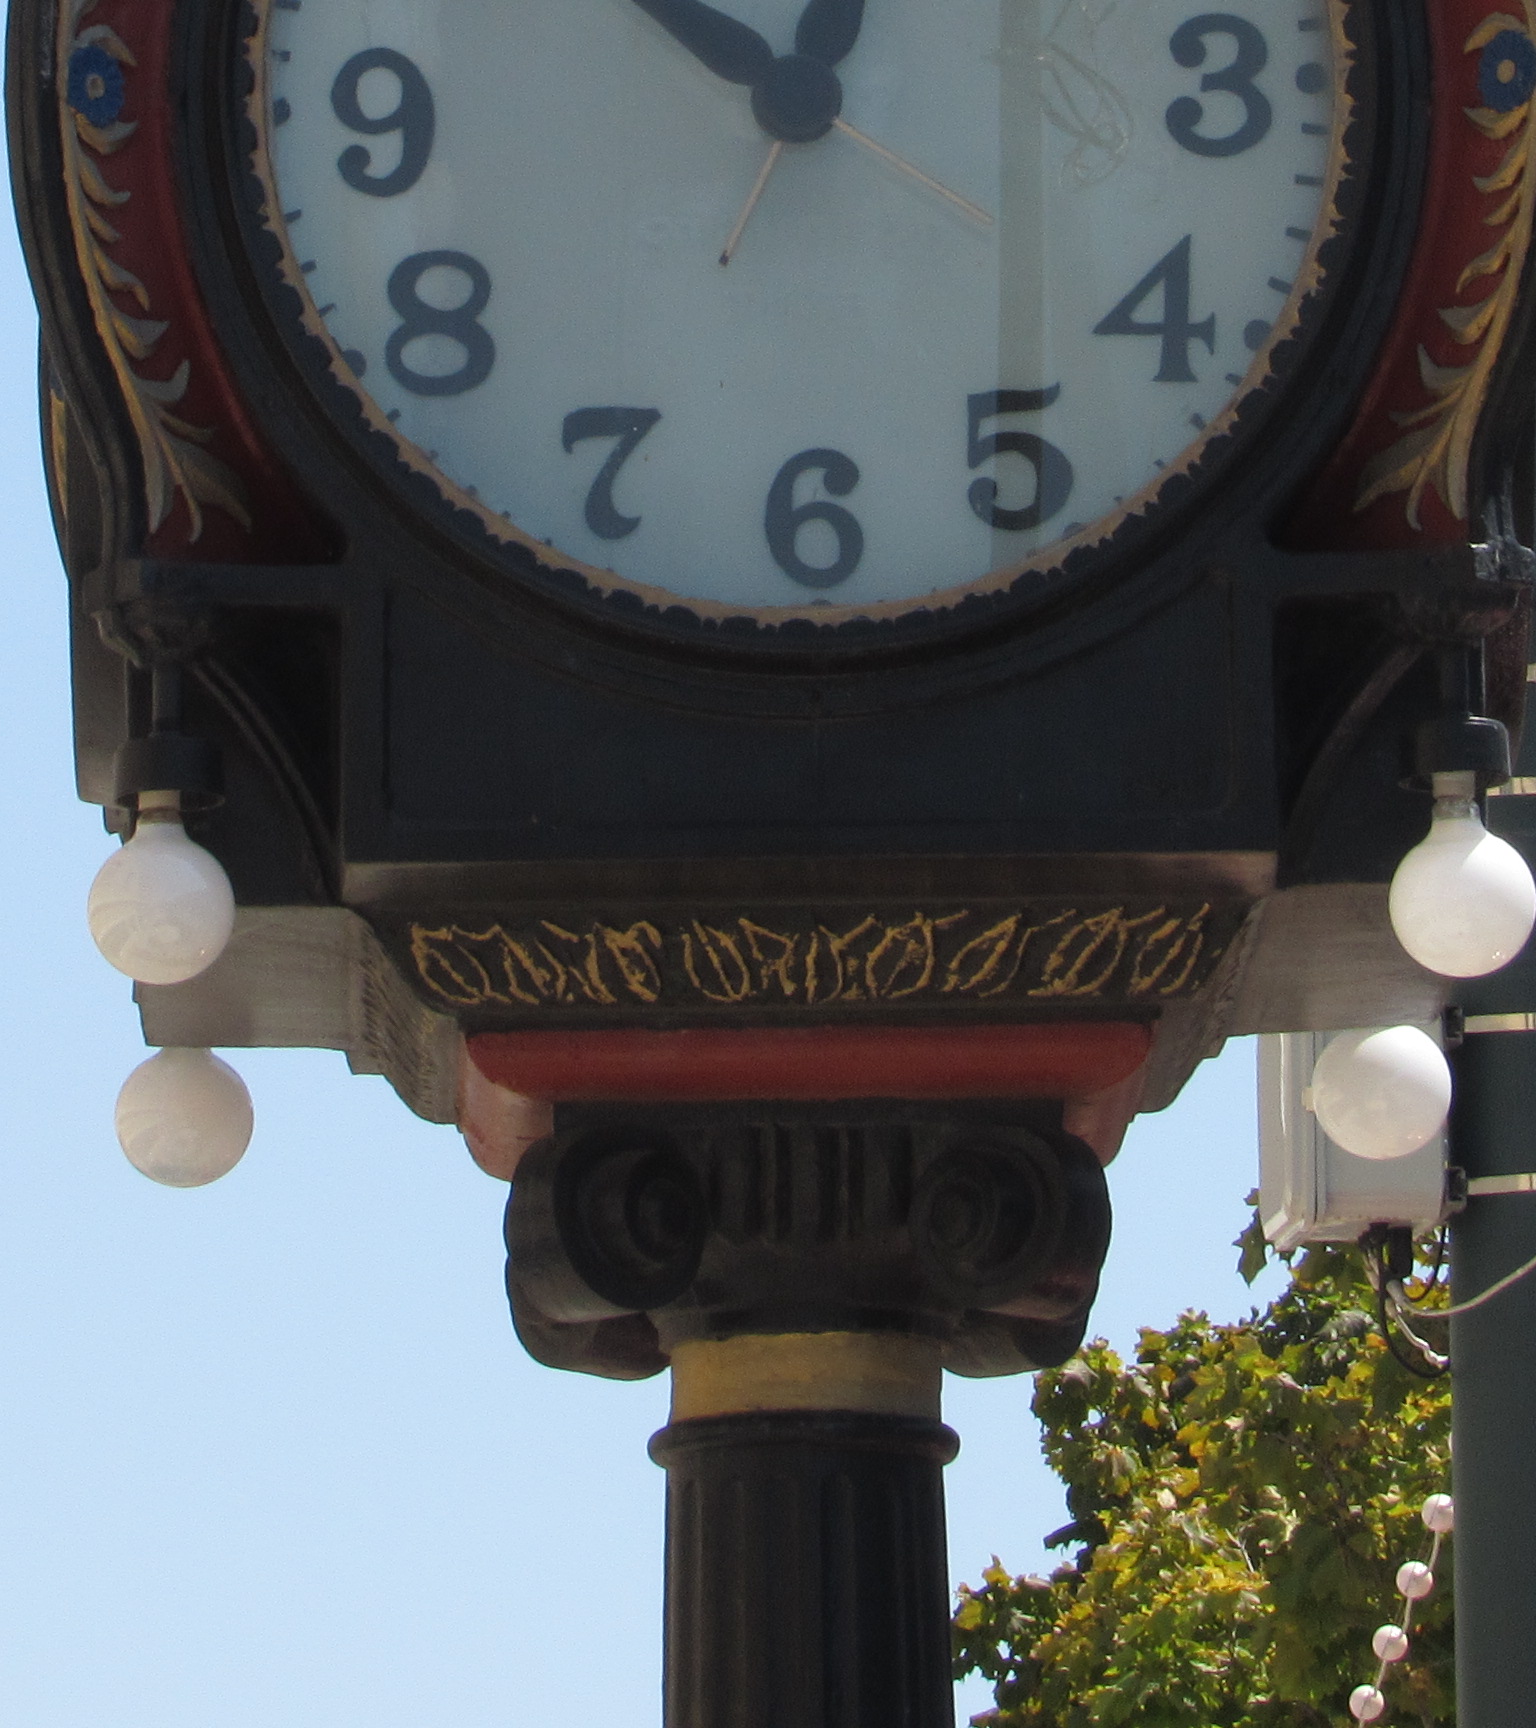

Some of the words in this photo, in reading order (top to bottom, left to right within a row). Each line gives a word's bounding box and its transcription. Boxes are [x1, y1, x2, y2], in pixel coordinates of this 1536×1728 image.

[330, 47, 435, 197] 9
[1165, 12, 1272, 158] 3
[383, 248, 495, 397] 8
[1091, 233, 1216, 383] 4
[561, 406, 662, 540] 7
[763, 448, 864, 589] 6
[966, 382, 1074, 532] 5
